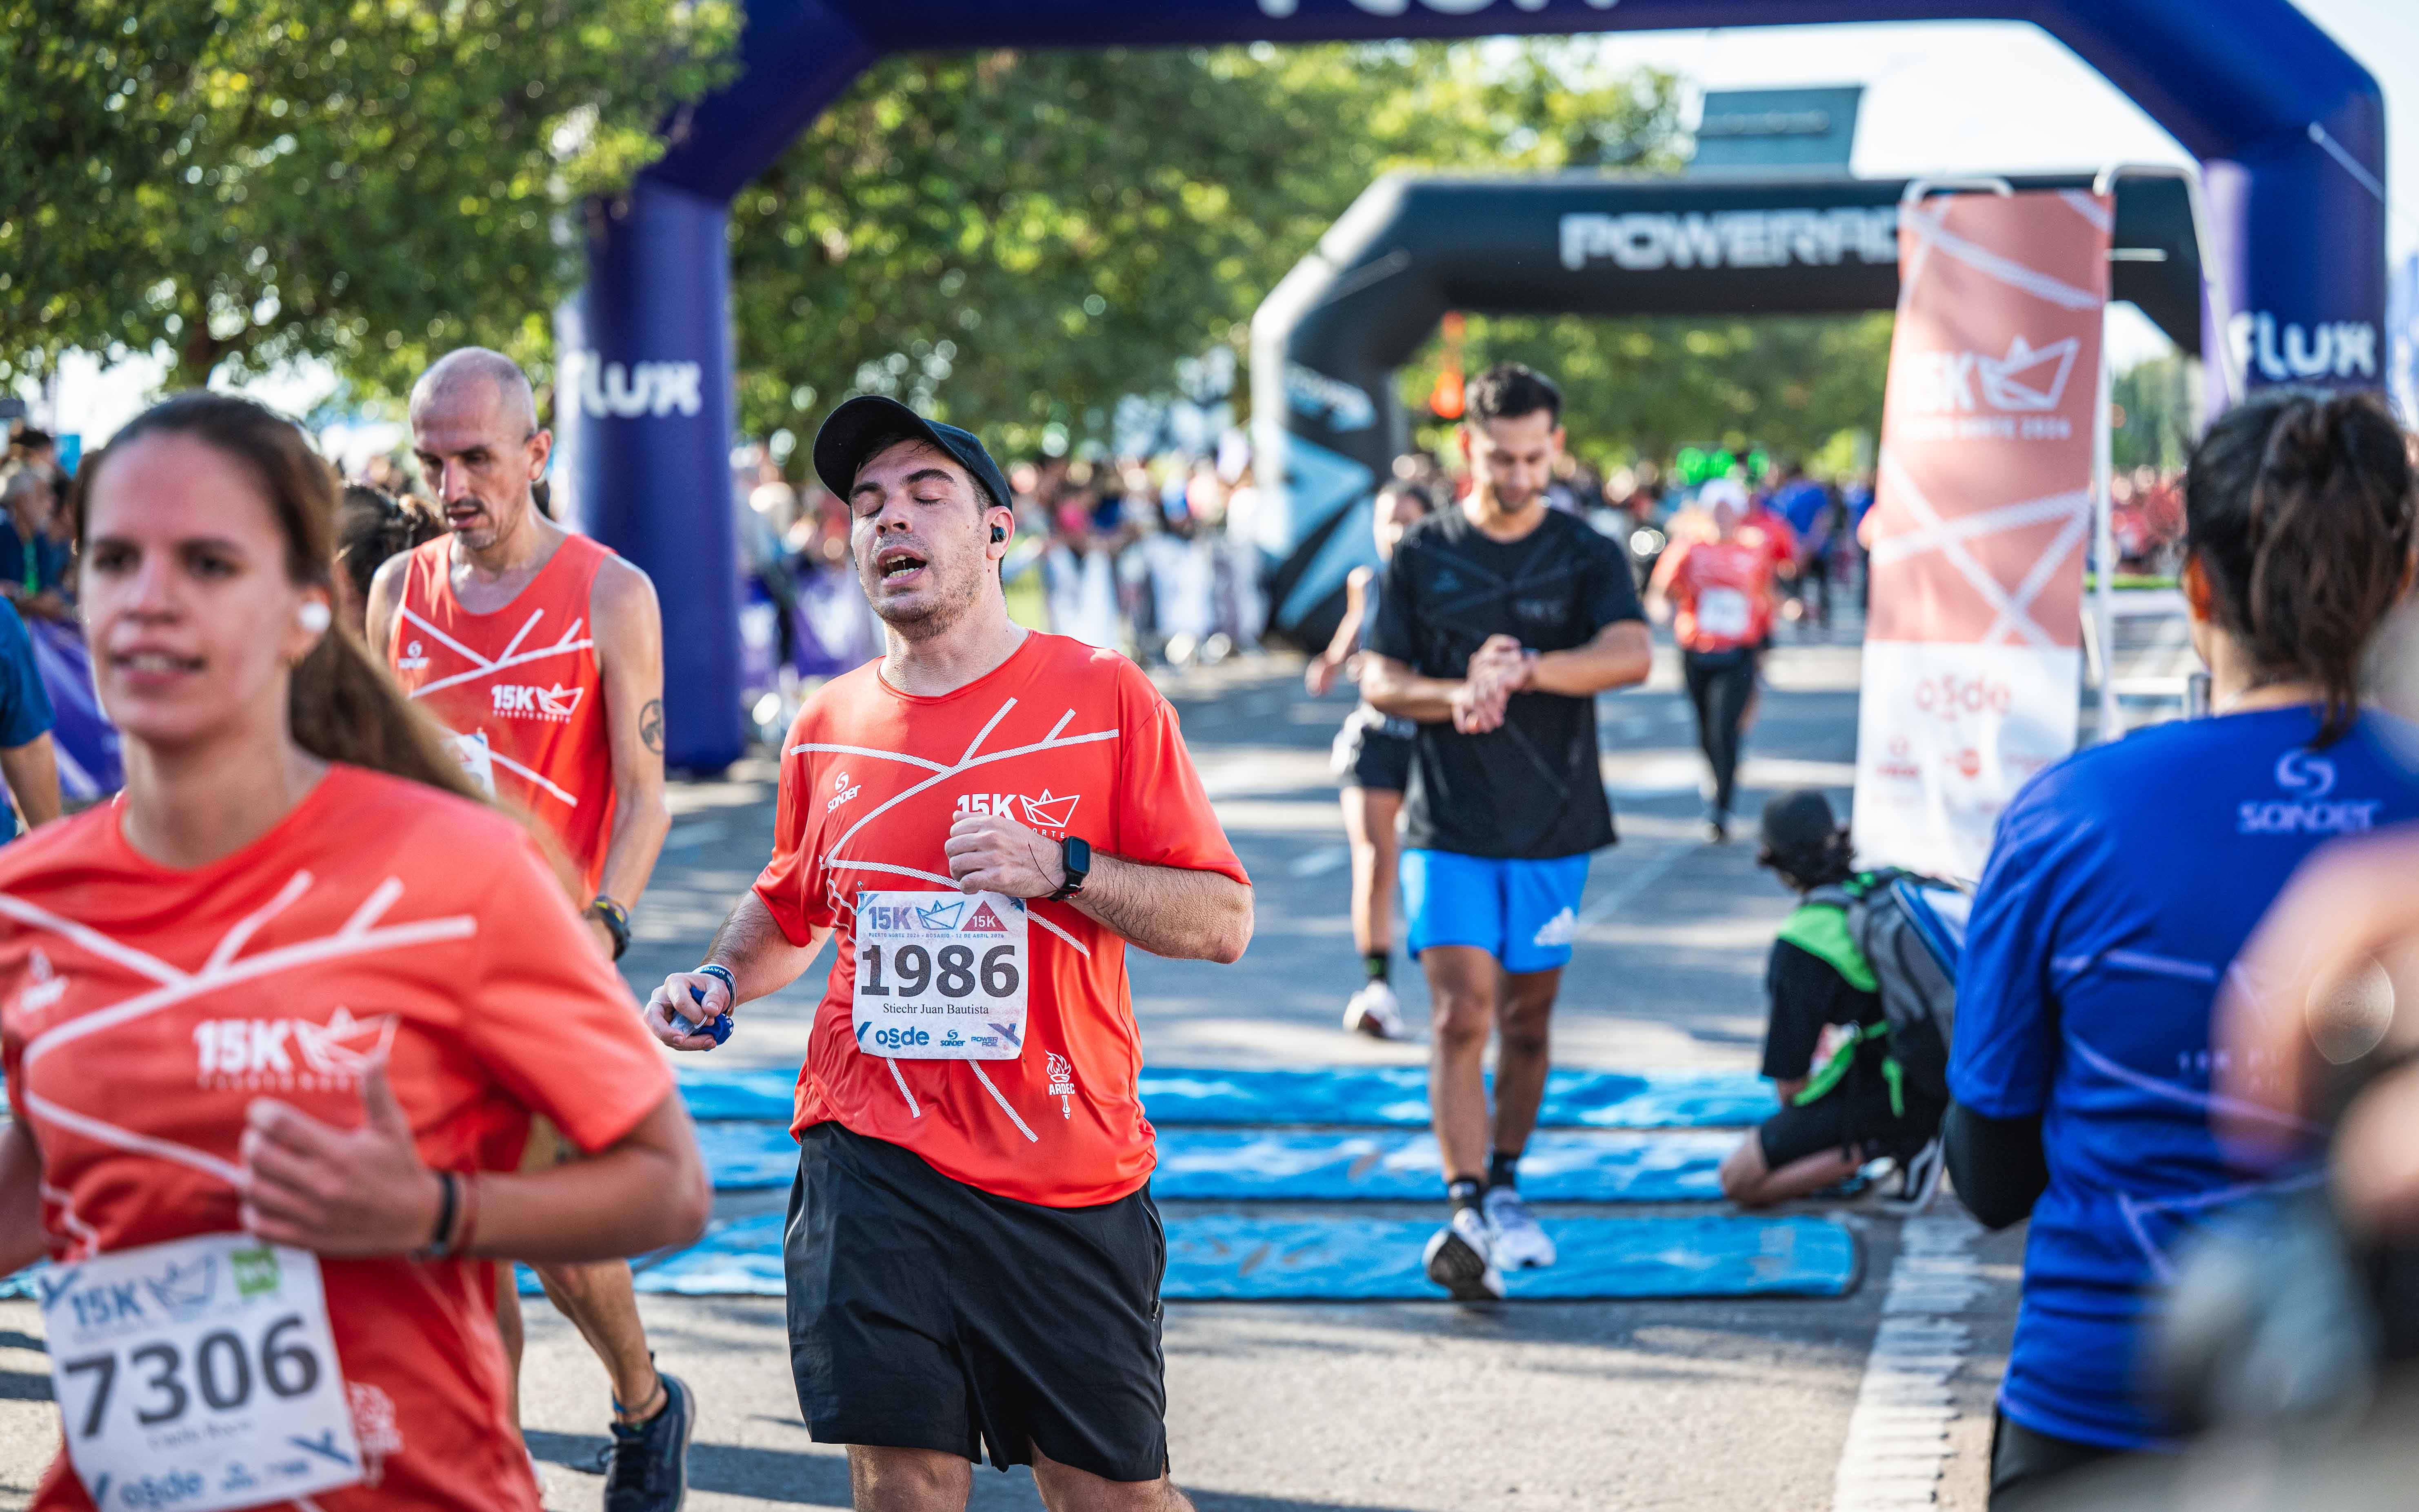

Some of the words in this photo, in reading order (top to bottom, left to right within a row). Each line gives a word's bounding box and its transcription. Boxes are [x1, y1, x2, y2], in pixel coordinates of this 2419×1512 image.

[491, 684, 535, 711] 15K
[957, 793, 1017, 821] 15K
[1032, 827, 1065, 839] ORTE
[869, 906, 911, 930] 15K
[972, 915, 996, 928] 15K
[861, 944, 1019, 998] 1986
[883, 1003, 918, 1014] Stiechr
[920, 1004, 943, 1014] Juan
[947, 1004, 989, 1014] Bautista
[193, 1018, 293, 1073] 15K
[875, 1026, 930, 1046] osde
[1049, 1083, 1075, 1095] ARDEC
[71, 1281, 144, 1326] 15K
[64, 1314, 320, 1439] 7306
